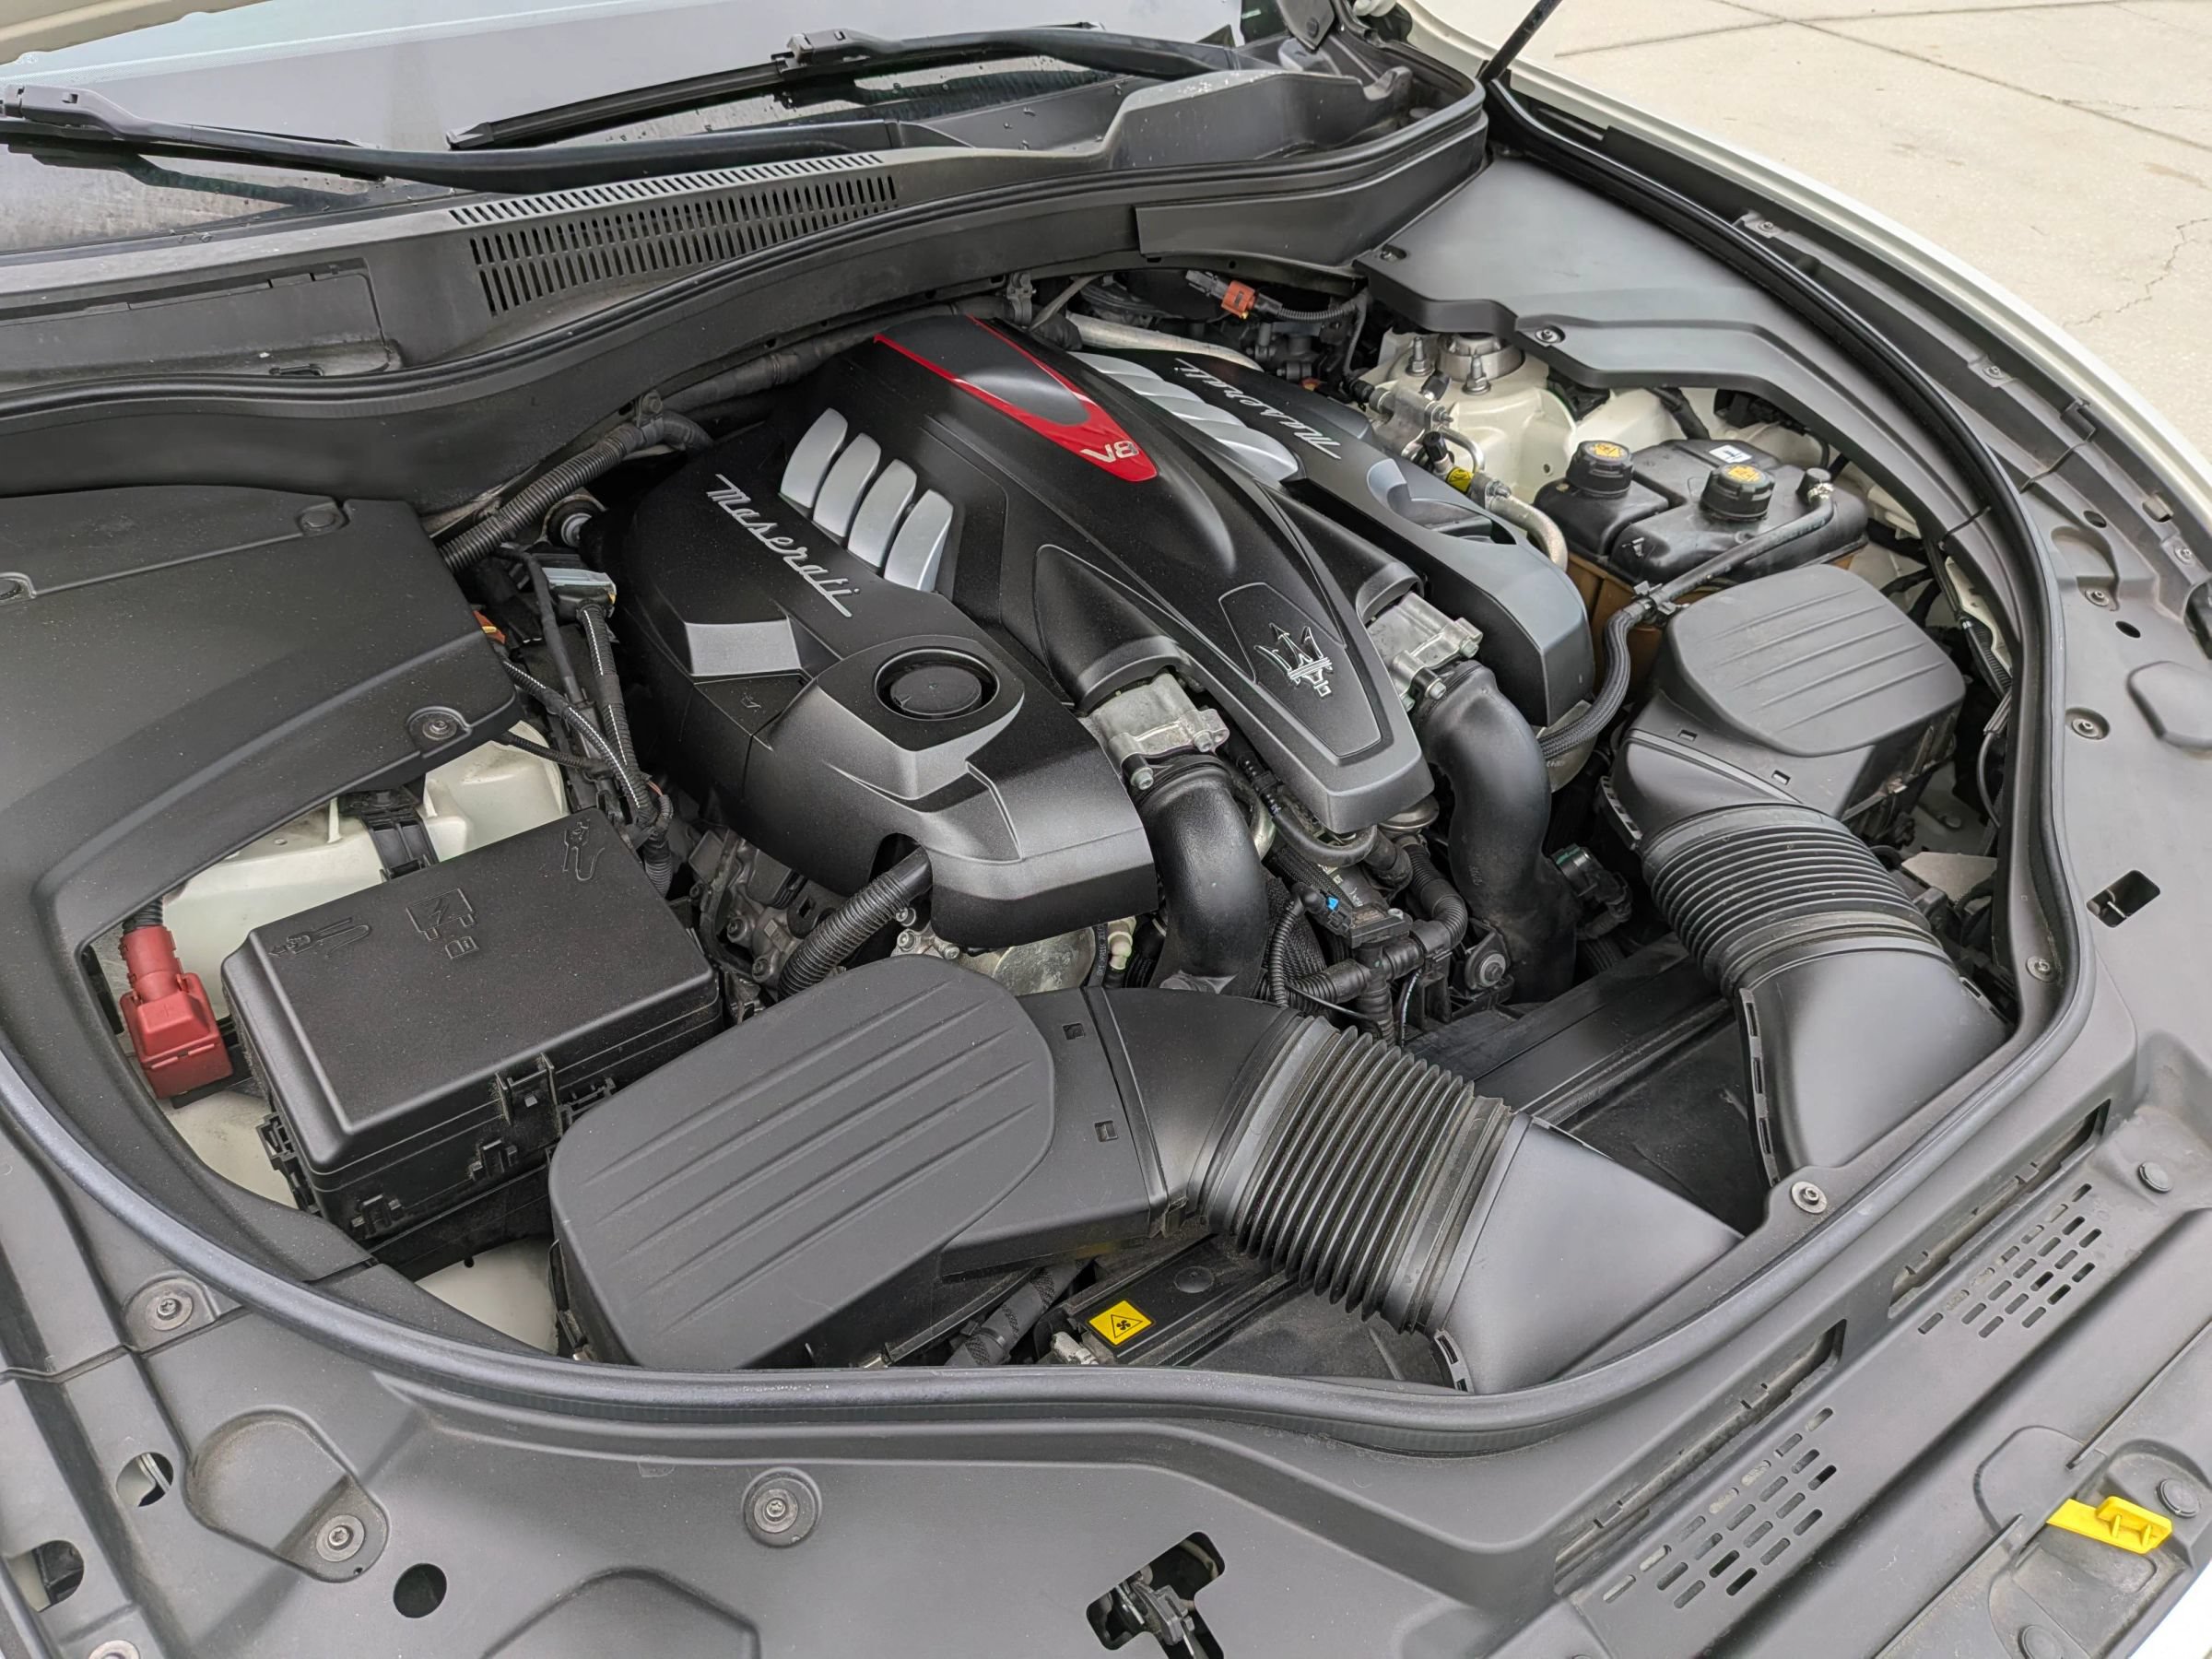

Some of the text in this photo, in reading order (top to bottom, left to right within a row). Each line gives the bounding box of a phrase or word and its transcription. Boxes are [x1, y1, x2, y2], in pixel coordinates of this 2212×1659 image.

[1079, 440, 1139, 463] V8
[1174, 358, 1341, 460] Maserati
[706, 474, 860, 618] Maserati
